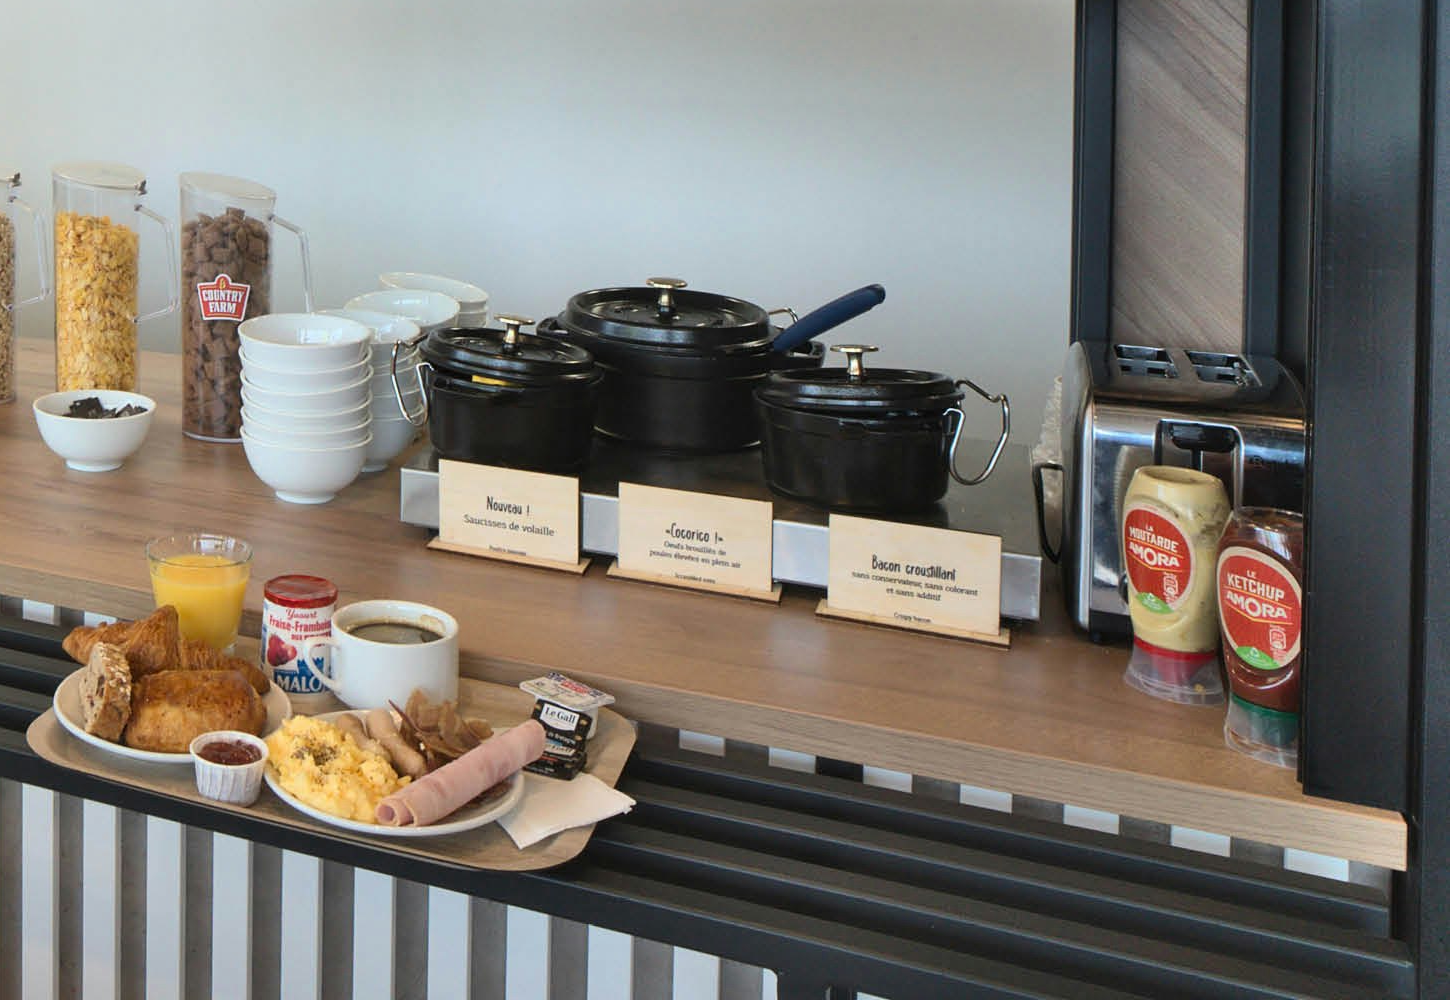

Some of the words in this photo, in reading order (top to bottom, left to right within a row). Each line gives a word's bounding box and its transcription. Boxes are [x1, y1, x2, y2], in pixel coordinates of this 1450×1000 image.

[202, 289, 245, 303] COUNTRY
[208, 301, 237, 314] FARM
[486, 495, 523, 516] Nouveau
[463, 513, 507, 529] Saucisses
[509, 521, 520, 532] de
[522, 525, 555, 537] volaille
[1129, 526, 1180, 553] MOUTARDE
[649, 549, 672, 559] poules
[674, 551, 699, 563] élevées
[711, 557, 729, 567] plein
[731, 561, 741, 569] air
[1129, 541, 1180, 567] AMORA
[871, 554, 901, 573] Bacon
[905, 563, 956, 582] croustillant
[1246, 570, 1256, 579] LE
[852, 571, 870, 580] sans
[924, 582, 944, 591] sans
[945, 585, 978, 597] colorant
[895, 589, 914, 598] sans
[916, 591, 942, 601] additif
[1227, 572, 1285, 602] KETCHUP
[1226, 590, 1288, 619] AMORA
[545, 707, 557, 717] Le
[557, 711, 577, 724] Gall
